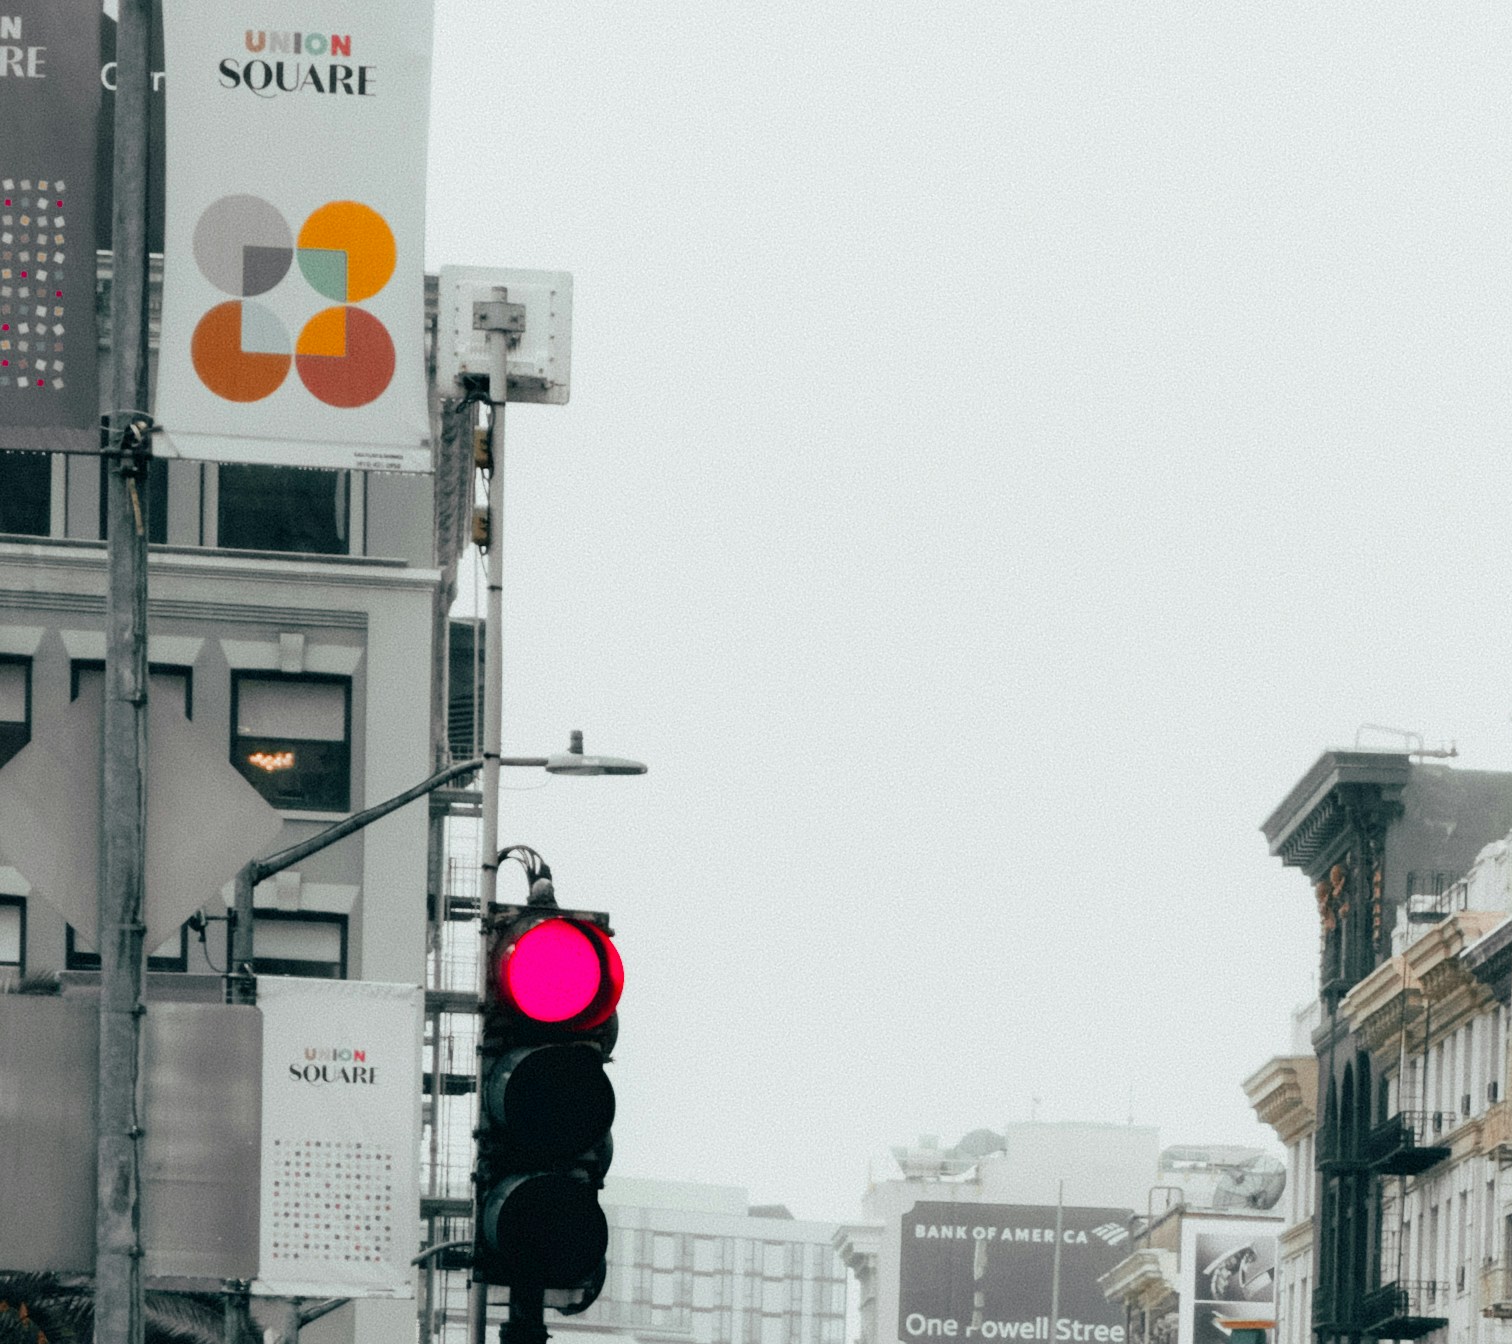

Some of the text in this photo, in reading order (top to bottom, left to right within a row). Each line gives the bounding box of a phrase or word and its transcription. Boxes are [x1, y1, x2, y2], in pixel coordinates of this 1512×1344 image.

[245, 29, 351, 57] UNION
[219, 58, 376, 98] SQUARE
[304, 1047, 366, 1063] UNION
[289, 1063, 379, 1088] SQUARE
[914, 1224, 1089, 1244] BANK OF AMERCA
[905, 1313, 958, 1336] One
